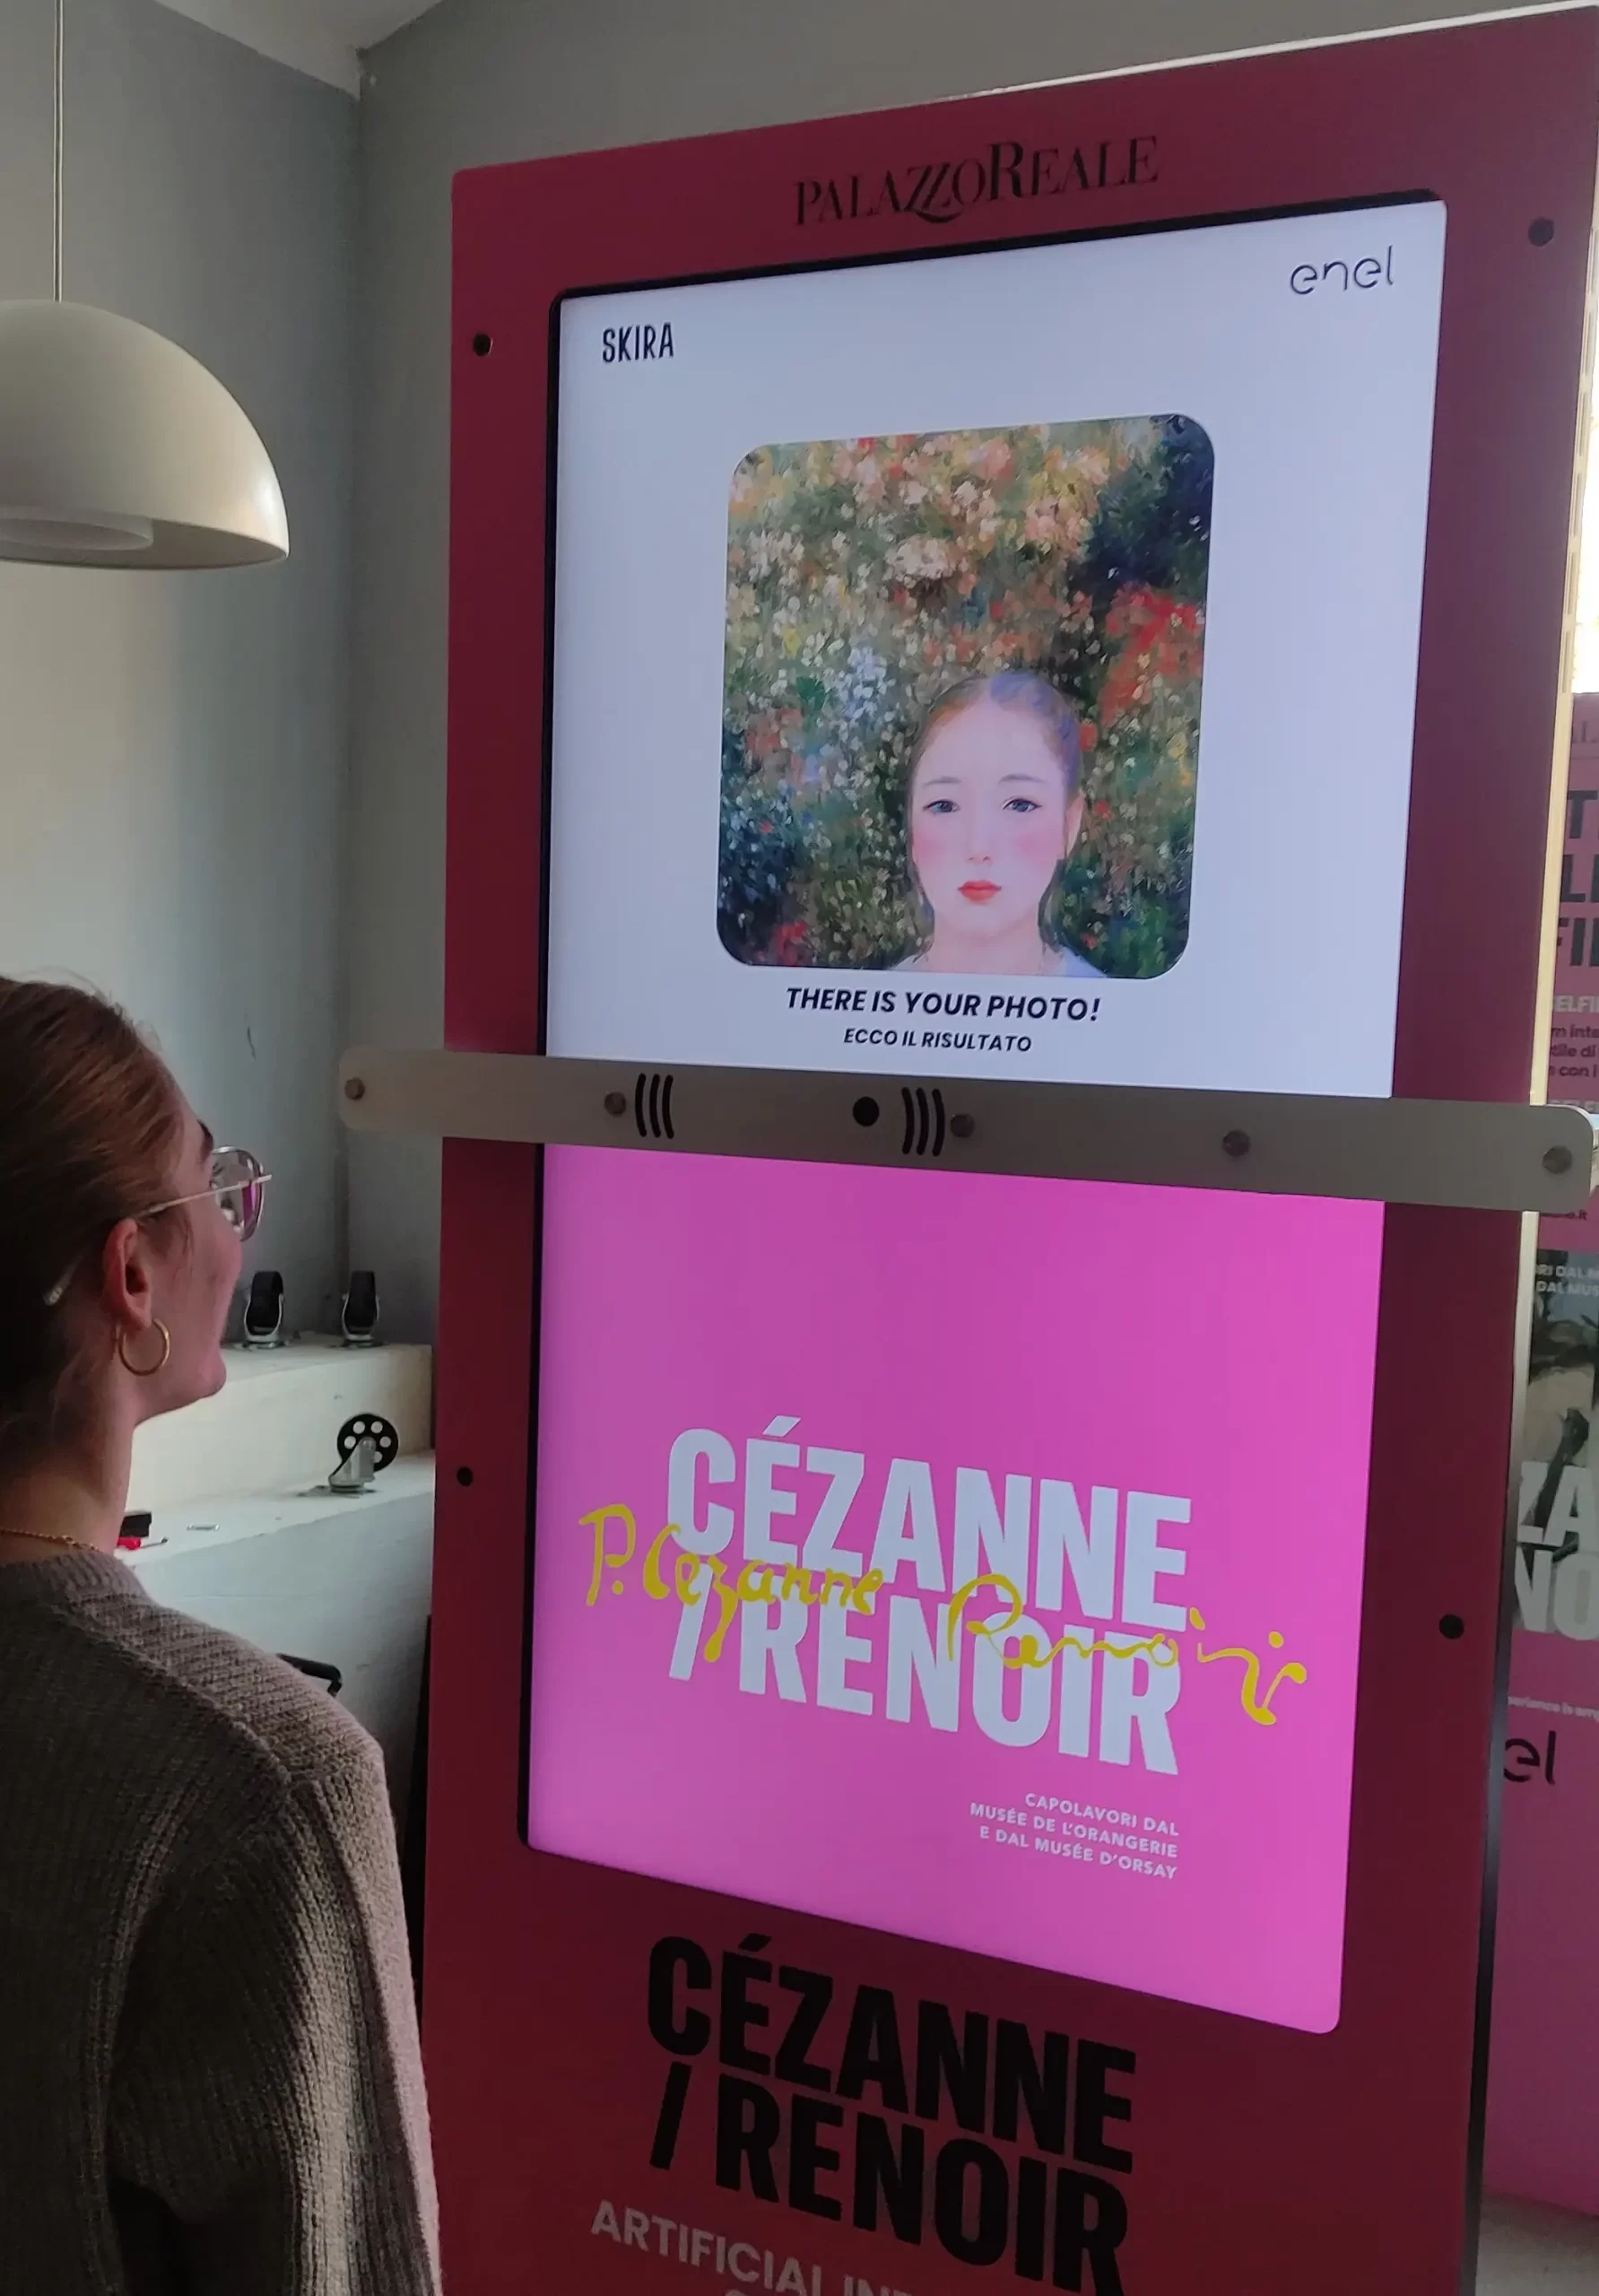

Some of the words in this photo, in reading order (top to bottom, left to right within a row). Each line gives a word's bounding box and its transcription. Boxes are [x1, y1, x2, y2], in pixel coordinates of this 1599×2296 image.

[1290, 245, 1396, 296] enel
[602, 322, 674, 364] SKIRA
[786, 987, 868, 1013] THERE
[872, 990, 896, 1013] IS
[906, 991, 980, 1017] YOUR
[986, 996, 1102, 1022] PHOTO!
[843, 1028, 898, 1046] ECCO
[901, 1031, 917, 1047] IL
[921, 1031, 1032, 1053] RISULTATO
[666, 1415, 1193, 1632] CÉZANNE
[969, 1802, 1027, 1826] MUSÉE
[1033, 1815, 1056, 1832] DE
[1025, 1792, 1137, 1829] CAPOLAVORI
[1143, 1817, 1179, 1837] DAL
[979, 1825, 990, 1839] E
[995, 1829, 1030, 1848] DAL
[1035, 1837, 1093, 1862] MUSÉE
[647, 1933, 1136, 2174] CÉZANNE
